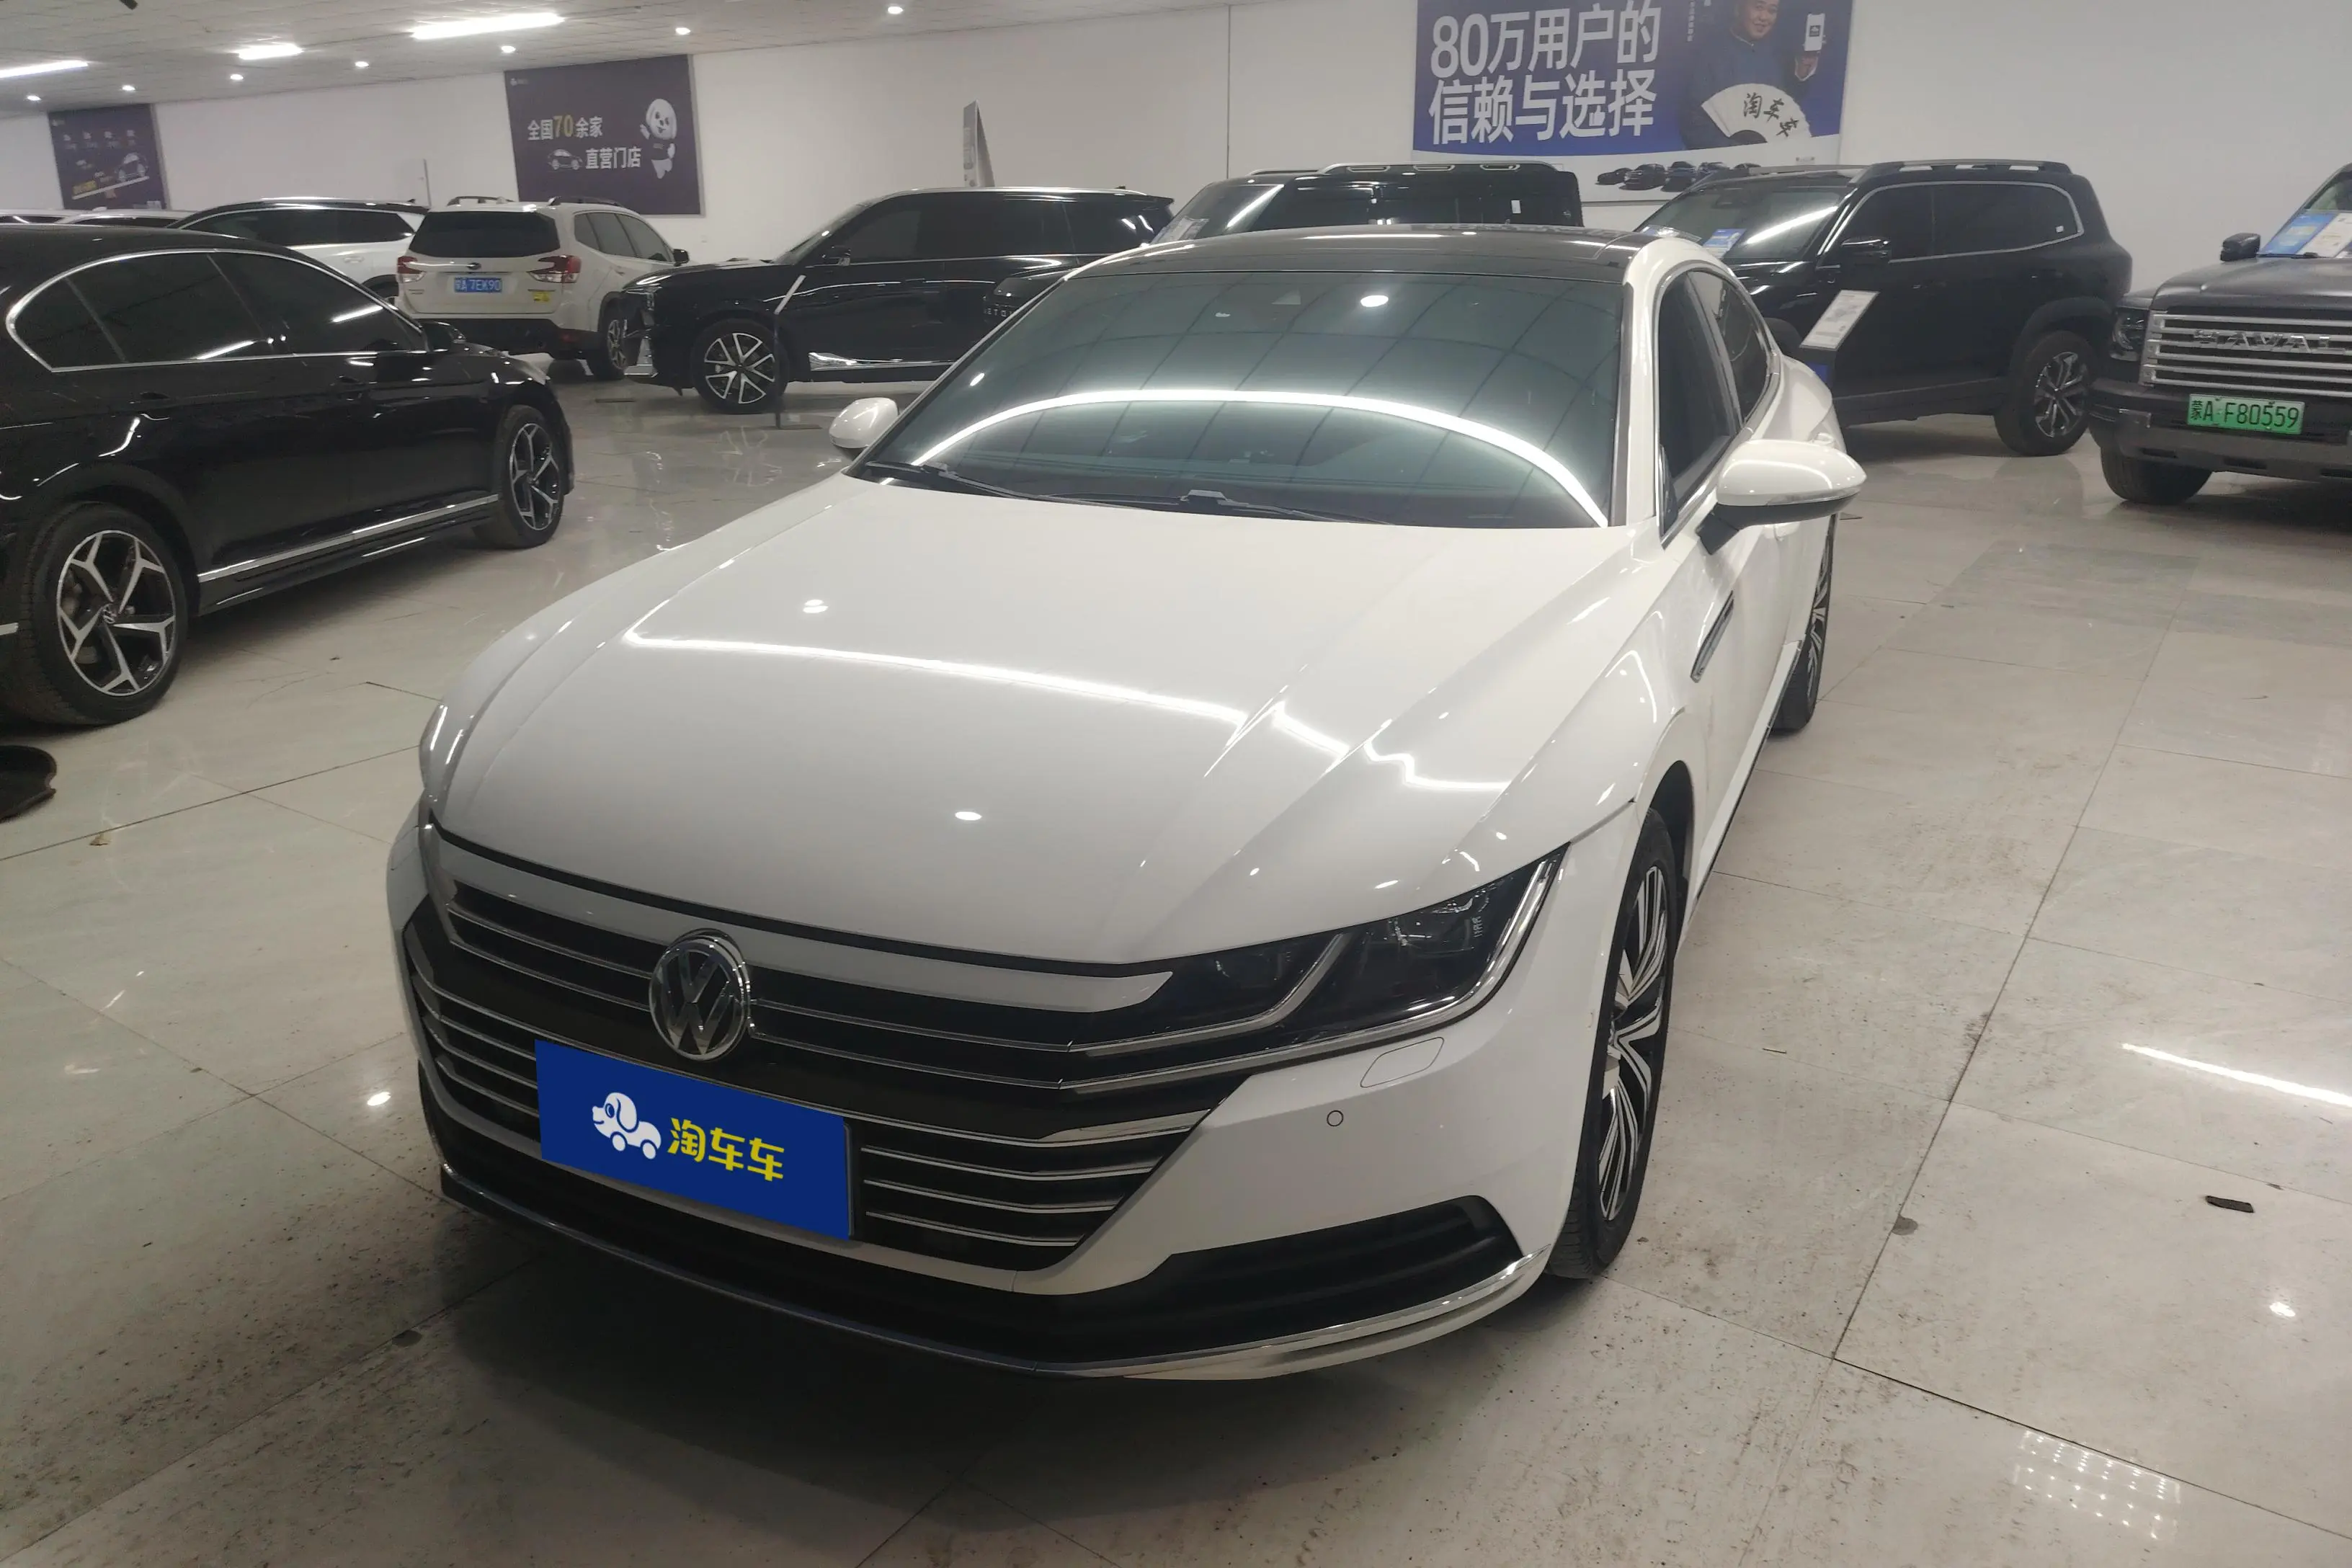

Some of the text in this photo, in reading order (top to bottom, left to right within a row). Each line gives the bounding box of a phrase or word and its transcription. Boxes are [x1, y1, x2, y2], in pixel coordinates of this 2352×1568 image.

[1430, 0, 1662, 78] 80万用户的
[527, 115, 603, 141] 全国70余家
[1428, 69, 1657, 144] 信赖与选择
[585, 146, 642, 169] 直营门店
